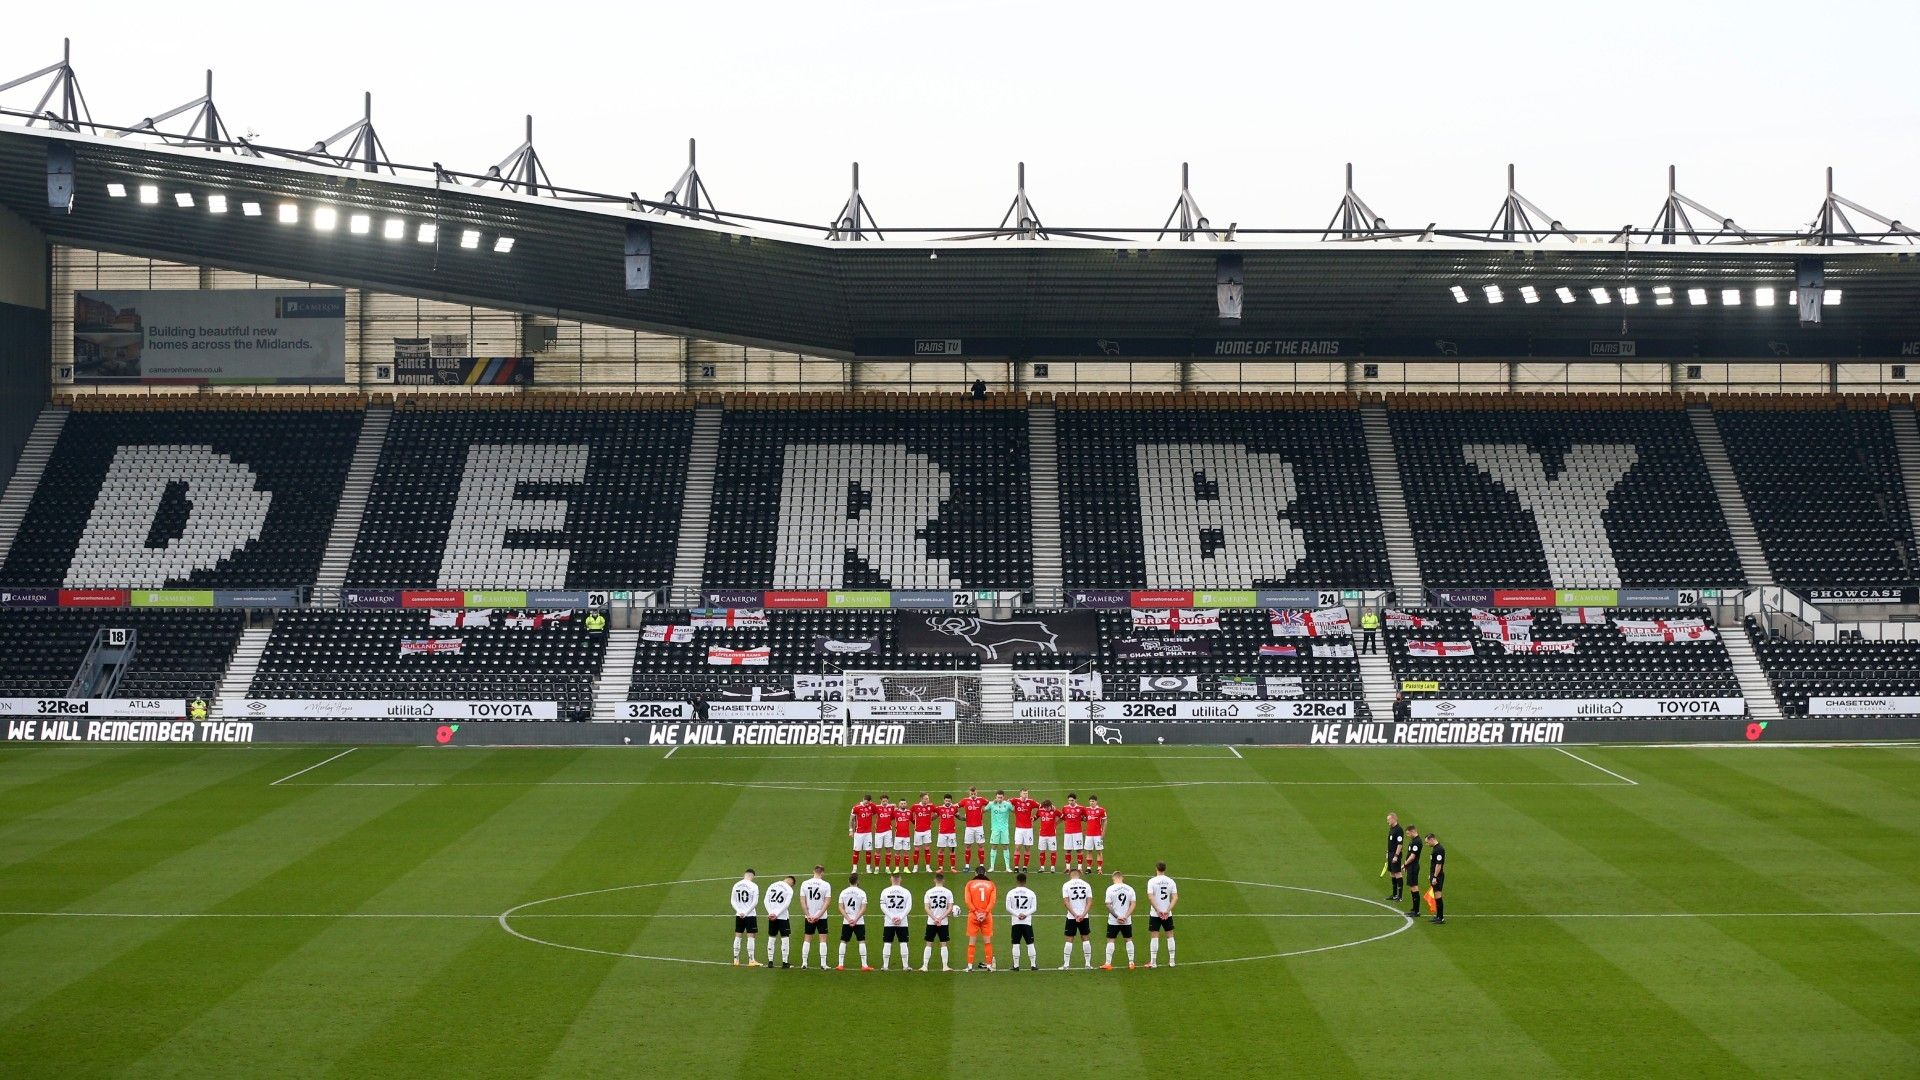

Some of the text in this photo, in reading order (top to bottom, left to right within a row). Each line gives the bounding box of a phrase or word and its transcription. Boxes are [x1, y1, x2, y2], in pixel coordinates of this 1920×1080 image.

[149, 327, 195, 339] Building
[199, 326, 250, 336] beautiful
[149, 339, 312, 349] homes across the Midlands.
[918, 342, 960, 352] RAMS TV
[1215, 341, 1340, 354] HOME OF THE RAMS
[1593, 344, 1619, 353] RAMS
[398, 358, 460, 369] SINCE I WAS
[61, 368, 71, 378] 17
[703, 366, 714, 376] 21
[62, 443, 1640, 592] DERBY
[12, 594, 47, 603] CAMERON
[359, 595, 394, 603] CAMERON
[590, 595, 604, 606] 20
[721, 596, 757, 604] CAMERON
[954, 595, 969, 606] 22
[1087, 595, 1123, 603] CAMERON
[1320, 594, 1335, 605] 24
[1451, 594, 1487, 602] CAMERON
[1679, 592, 1693, 604] 26
[1661, 625, 1706, 634] COUNTY
[111, 631, 124, 643] 18
[37, 701, 89, 713] 32Red
[387, 703, 421, 715] utilita
[468, 704, 533, 716] TOYOTA
[629, 704, 683, 717] 32Red
[1021, 705, 1056, 717] utilita
[1123, 704, 1176, 717] 32Red
[1192, 704, 1227, 716] utilita
[1292, 704, 1346, 716] 32Red
[1577, 704, 1611, 715] utilita
[1657, 701, 1720, 714] TOYOTA
[7, 721, 254, 742] WE WILL REMEMBER THEM
[648, 724, 905, 745] WE WILL REMEMBER THEM
[1311, 723, 1565, 744] WE WILL REMEMBER THEM
[736, 889, 749, 903] 10
[771, 889, 785, 904] 26
[808, 887, 821, 900] 16
[978, 887, 985, 902] 1
[1070, 886, 1087, 901] 33
[1160, 886, 1168, 900] 5
[847, 897, 856, 910] 4
[887, 895, 904, 909] 32
[930, 895, 947, 909] 38
[1014, 895, 1028, 909] 12
[1118, 893, 1127, 906] 9
